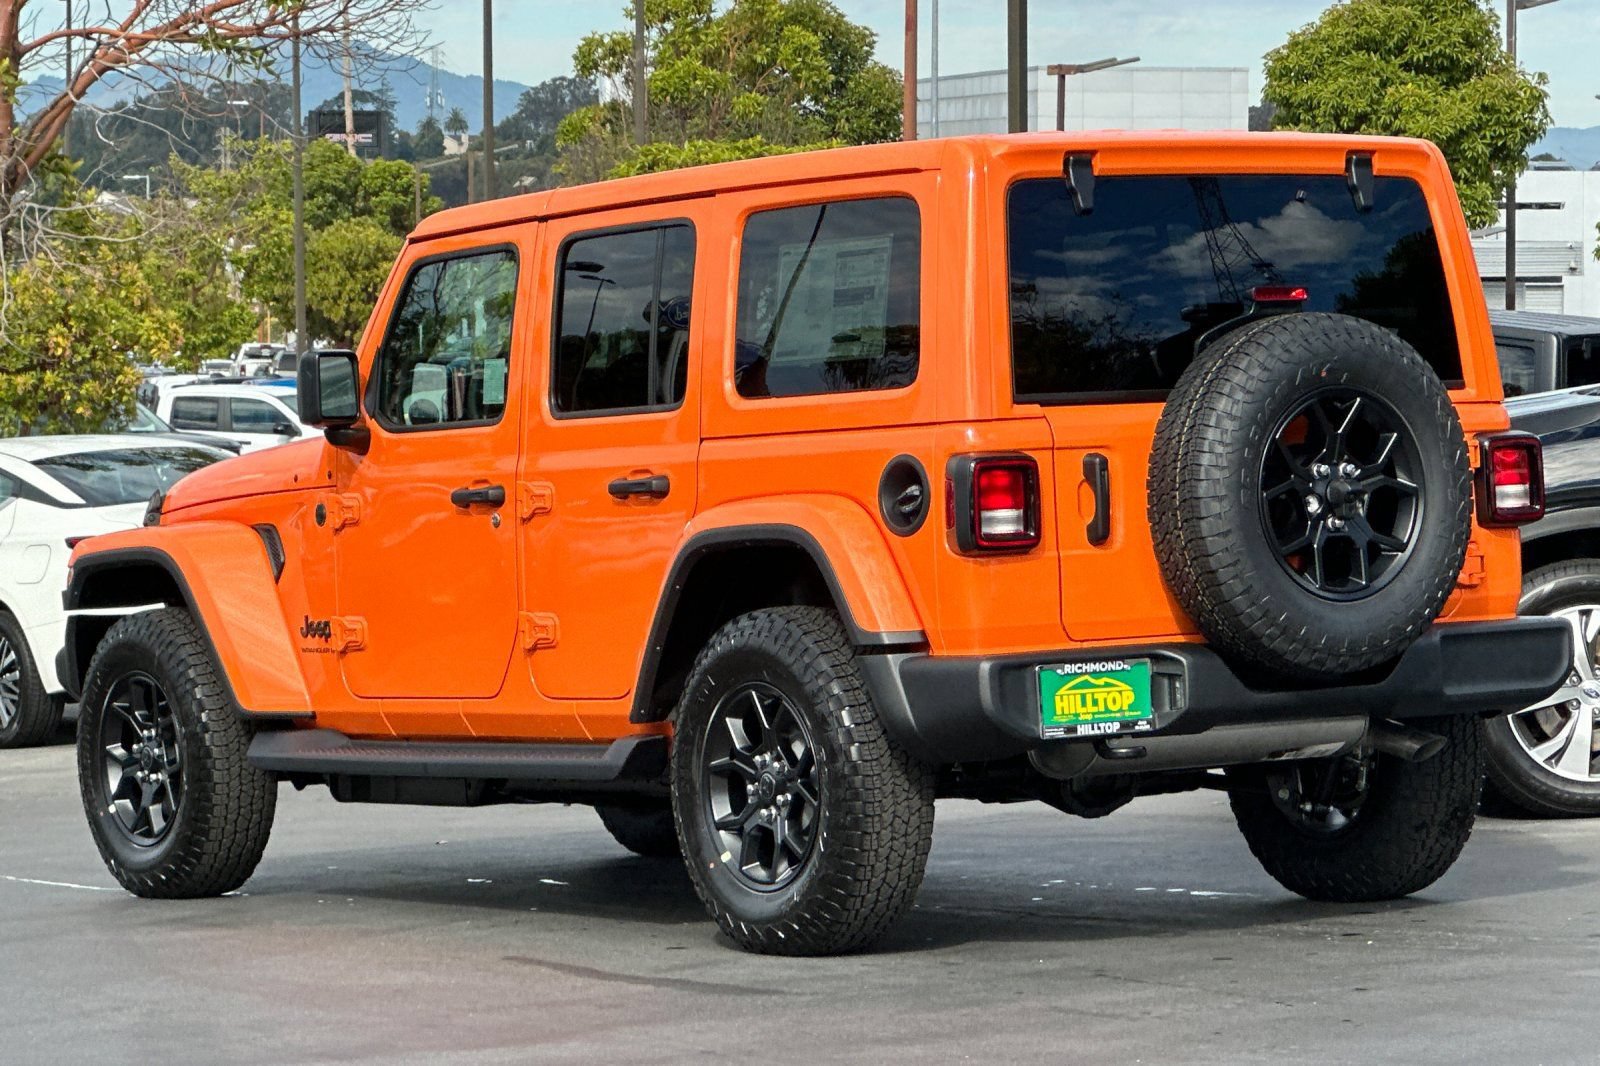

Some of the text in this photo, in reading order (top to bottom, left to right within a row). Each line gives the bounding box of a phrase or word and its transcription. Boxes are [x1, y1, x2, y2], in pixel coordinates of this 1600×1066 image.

[300, 615, 331, 643] Jeep
[1064, 661, 1124, 674] RICHMOND
[1055, 690, 1135, 715] HILLTOP
[1077, 721, 1121, 735] HILLTOP
